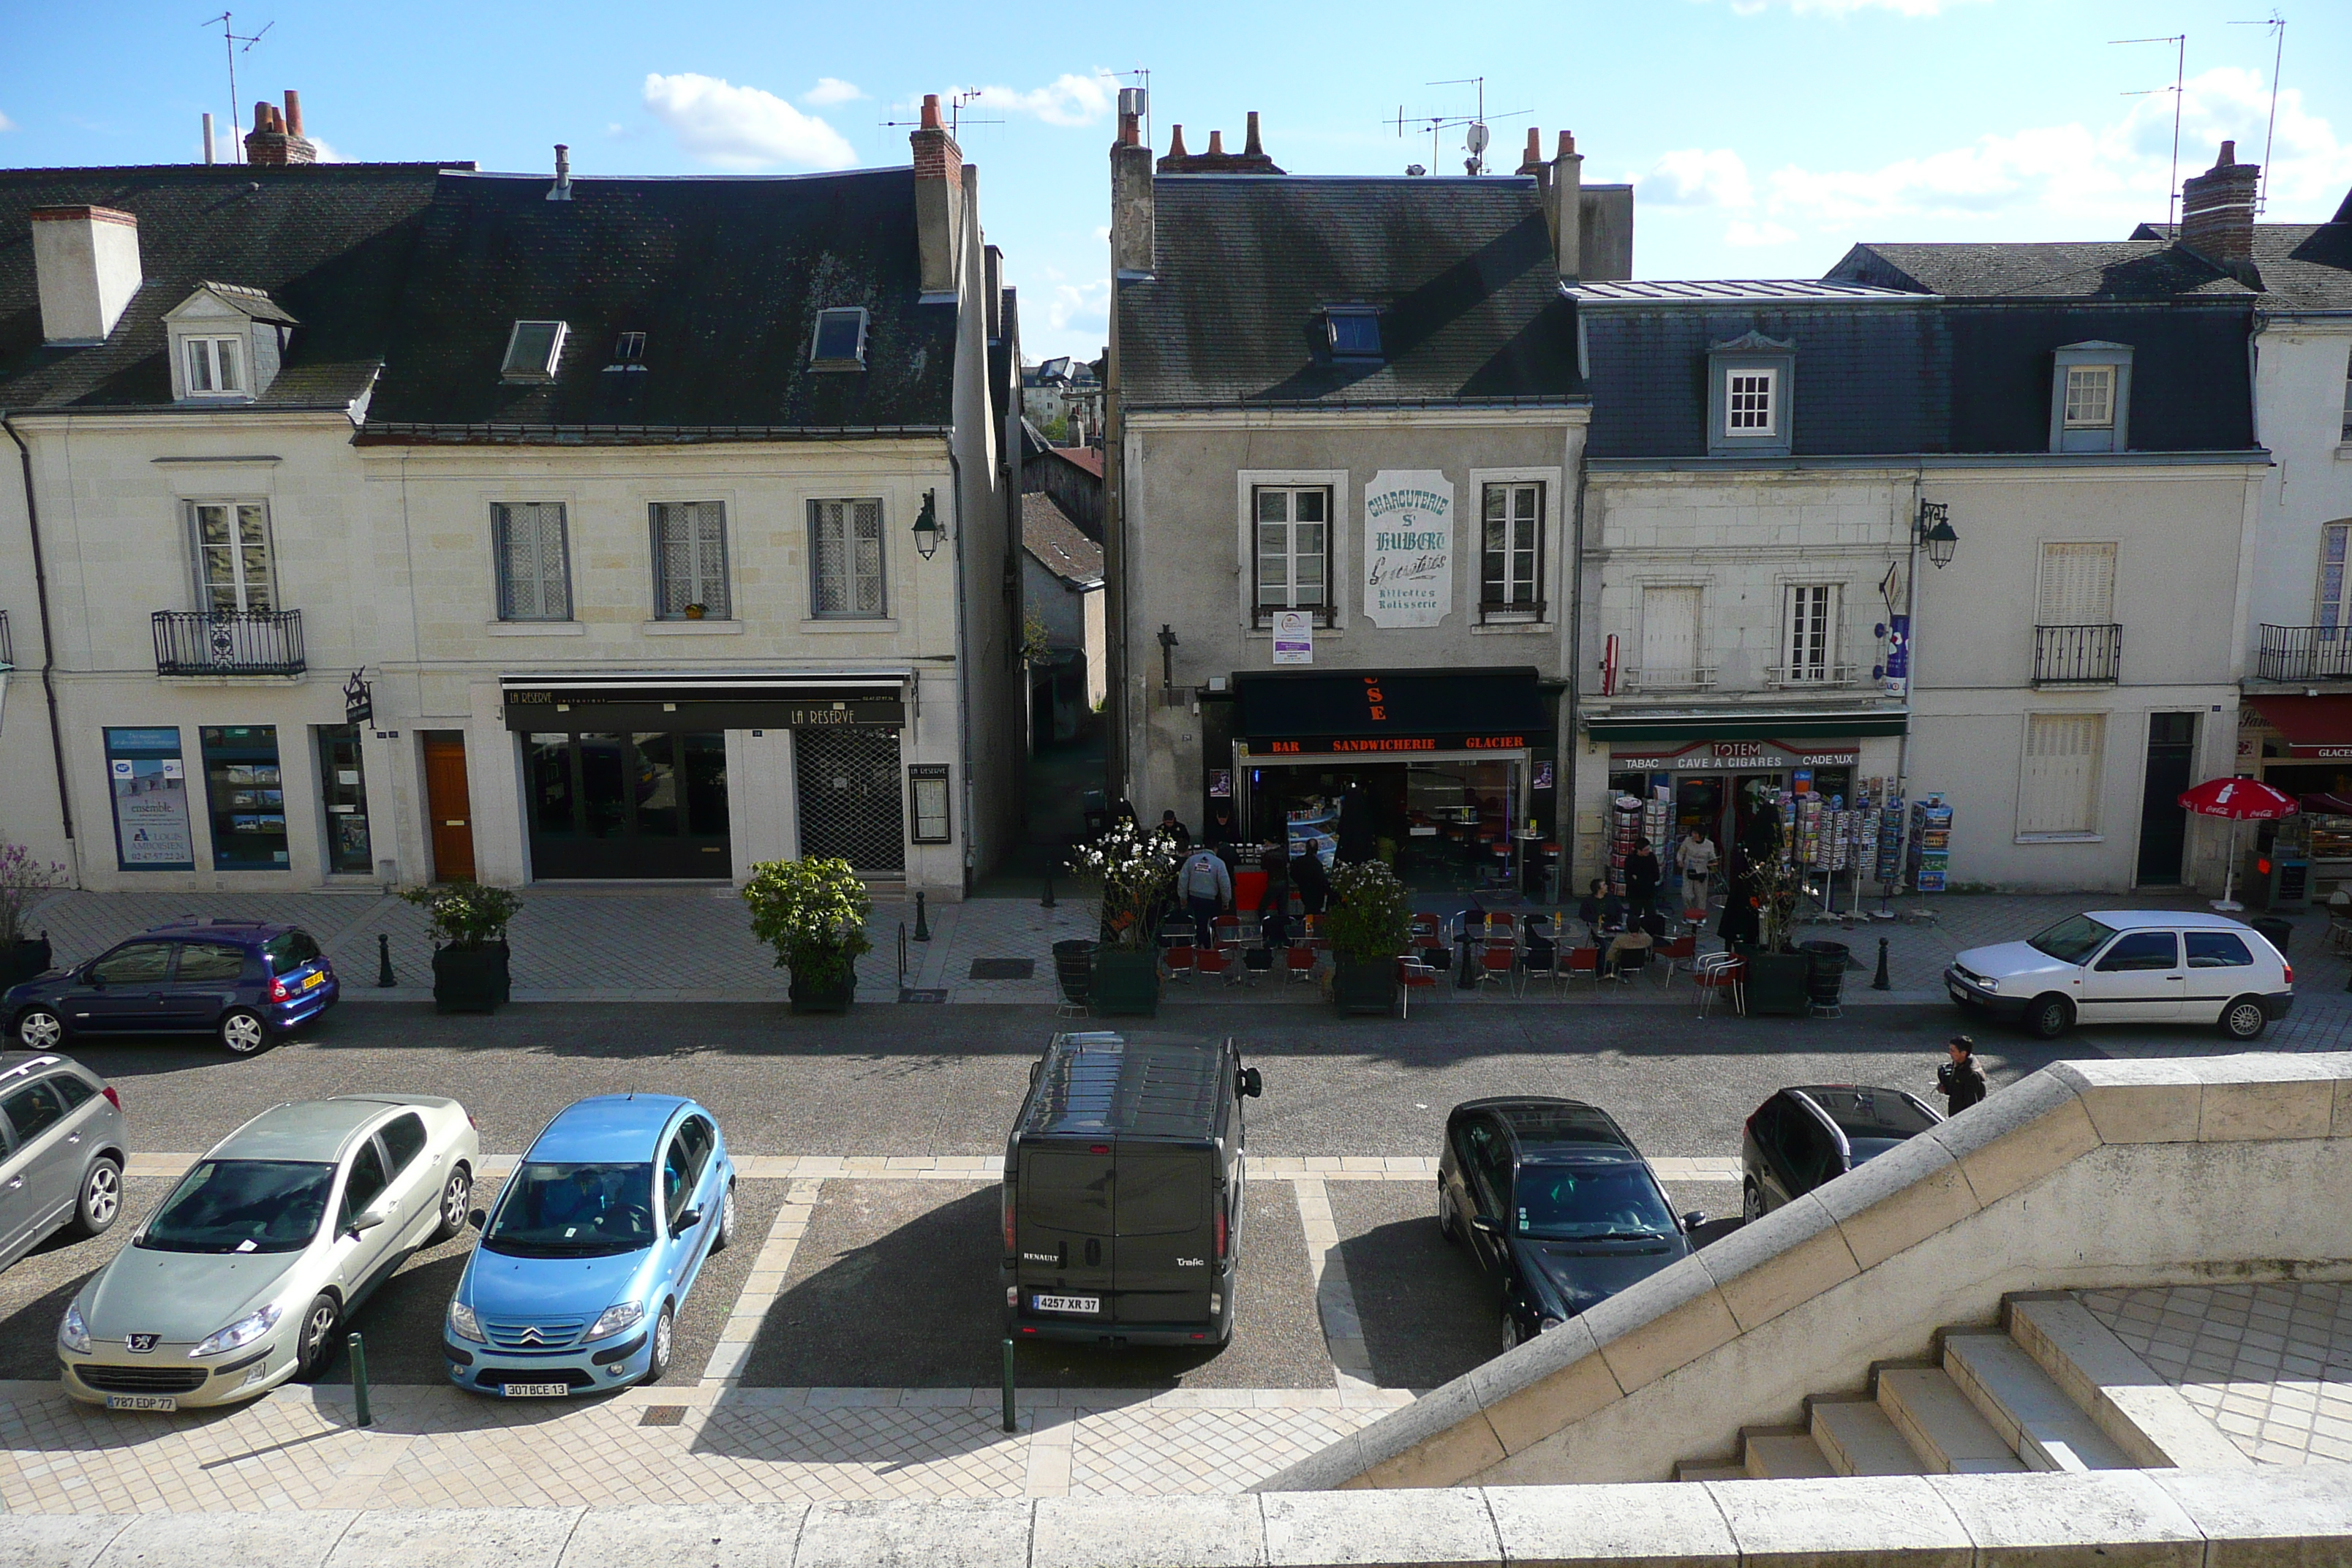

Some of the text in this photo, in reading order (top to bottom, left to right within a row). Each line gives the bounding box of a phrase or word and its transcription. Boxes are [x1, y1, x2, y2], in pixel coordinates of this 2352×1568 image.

[1368, 489, 1449, 517] CHARCUTERIE
[1376, 532, 1445, 551] HUBERT
[510, 692, 519, 703] LA
[521, 692, 552, 703] RESERVE
[791, 710, 855, 724] LA RESERVE
[1272, 736, 1524, 752] BAR SANDWICHERIE GLACIER
[1714, 743, 1761, 756] TOTEM
[1626, 759, 1659, 769] TABAC
[1678, 758, 1708, 768] CAVE
[1727, 757, 1782, 767] CIGARES
[1023, 1252, 1059, 1262] RENAULT
[1176, 1257, 1205, 1267] Trafic
[1041, 1297, 1097, 1311] 4257 XR 37
[552, 1384, 565, 1394] 13
[113, 1397, 173, 1409] 787 EDP 77
